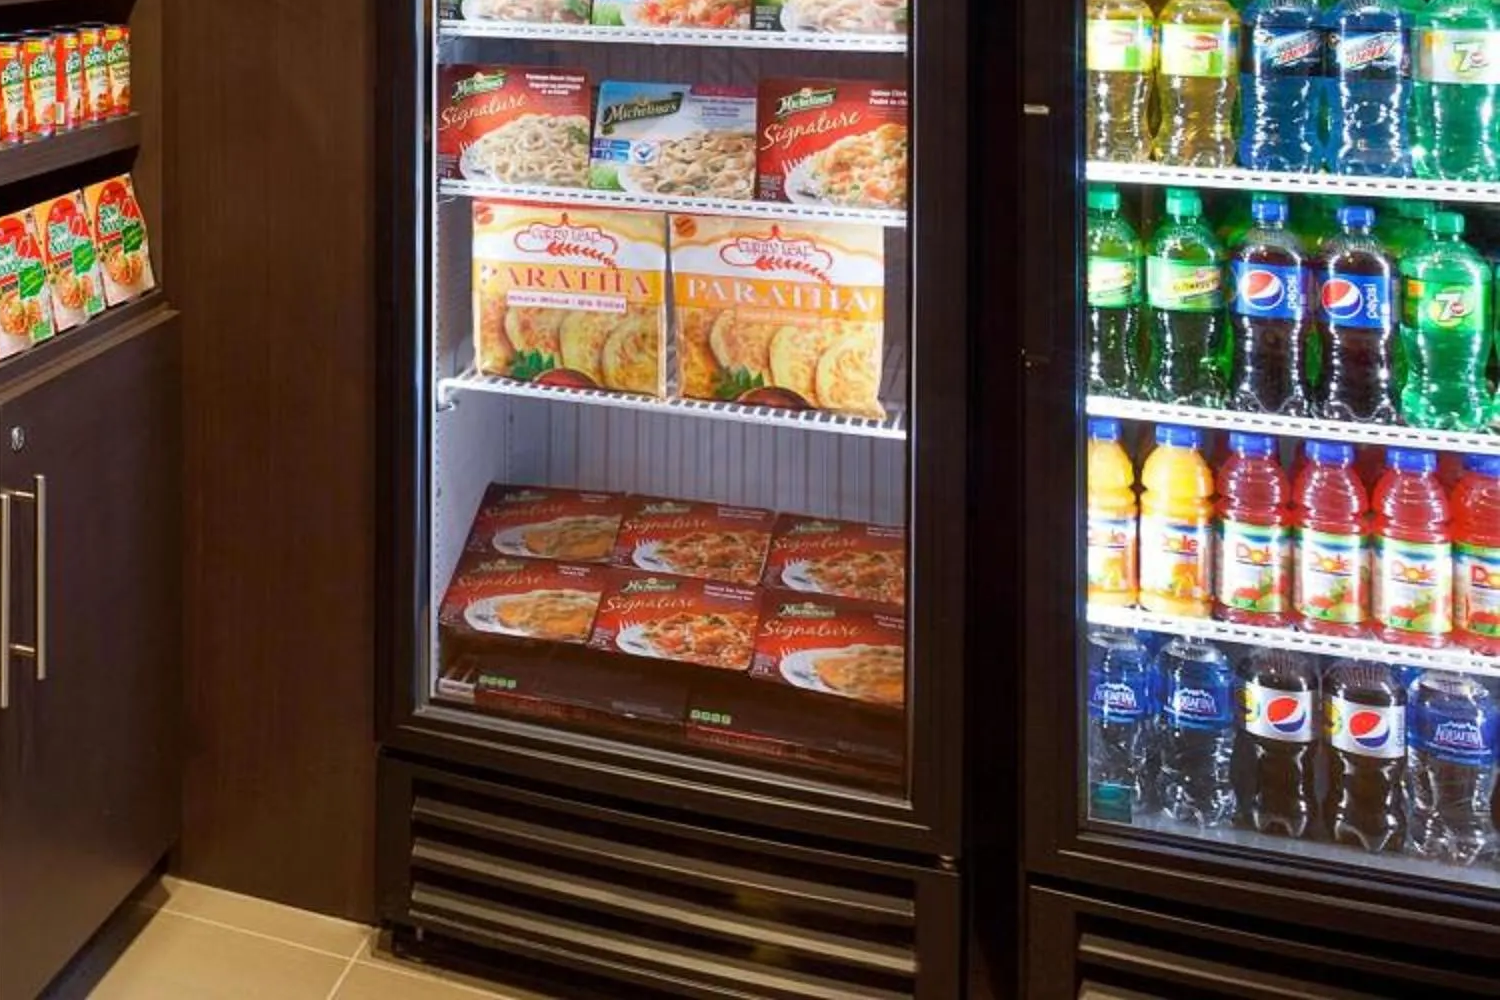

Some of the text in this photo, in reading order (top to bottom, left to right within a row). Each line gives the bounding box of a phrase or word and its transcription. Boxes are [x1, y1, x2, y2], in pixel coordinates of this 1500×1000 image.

[438, 92, 528, 131] Signature
[602, 103, 678, 126] Michelina's
[760, 110, 861, 151] Signature
[687, 278, 876, 314] PARATHA
[620, 515, 708, 534] Signature
[1472, 564, 1500, 584] Do
[601, 596, 696, 616] Signature
[759, 619, 861, 641] Signature
[1434, 726, 1483, 750] AQUAFINA
